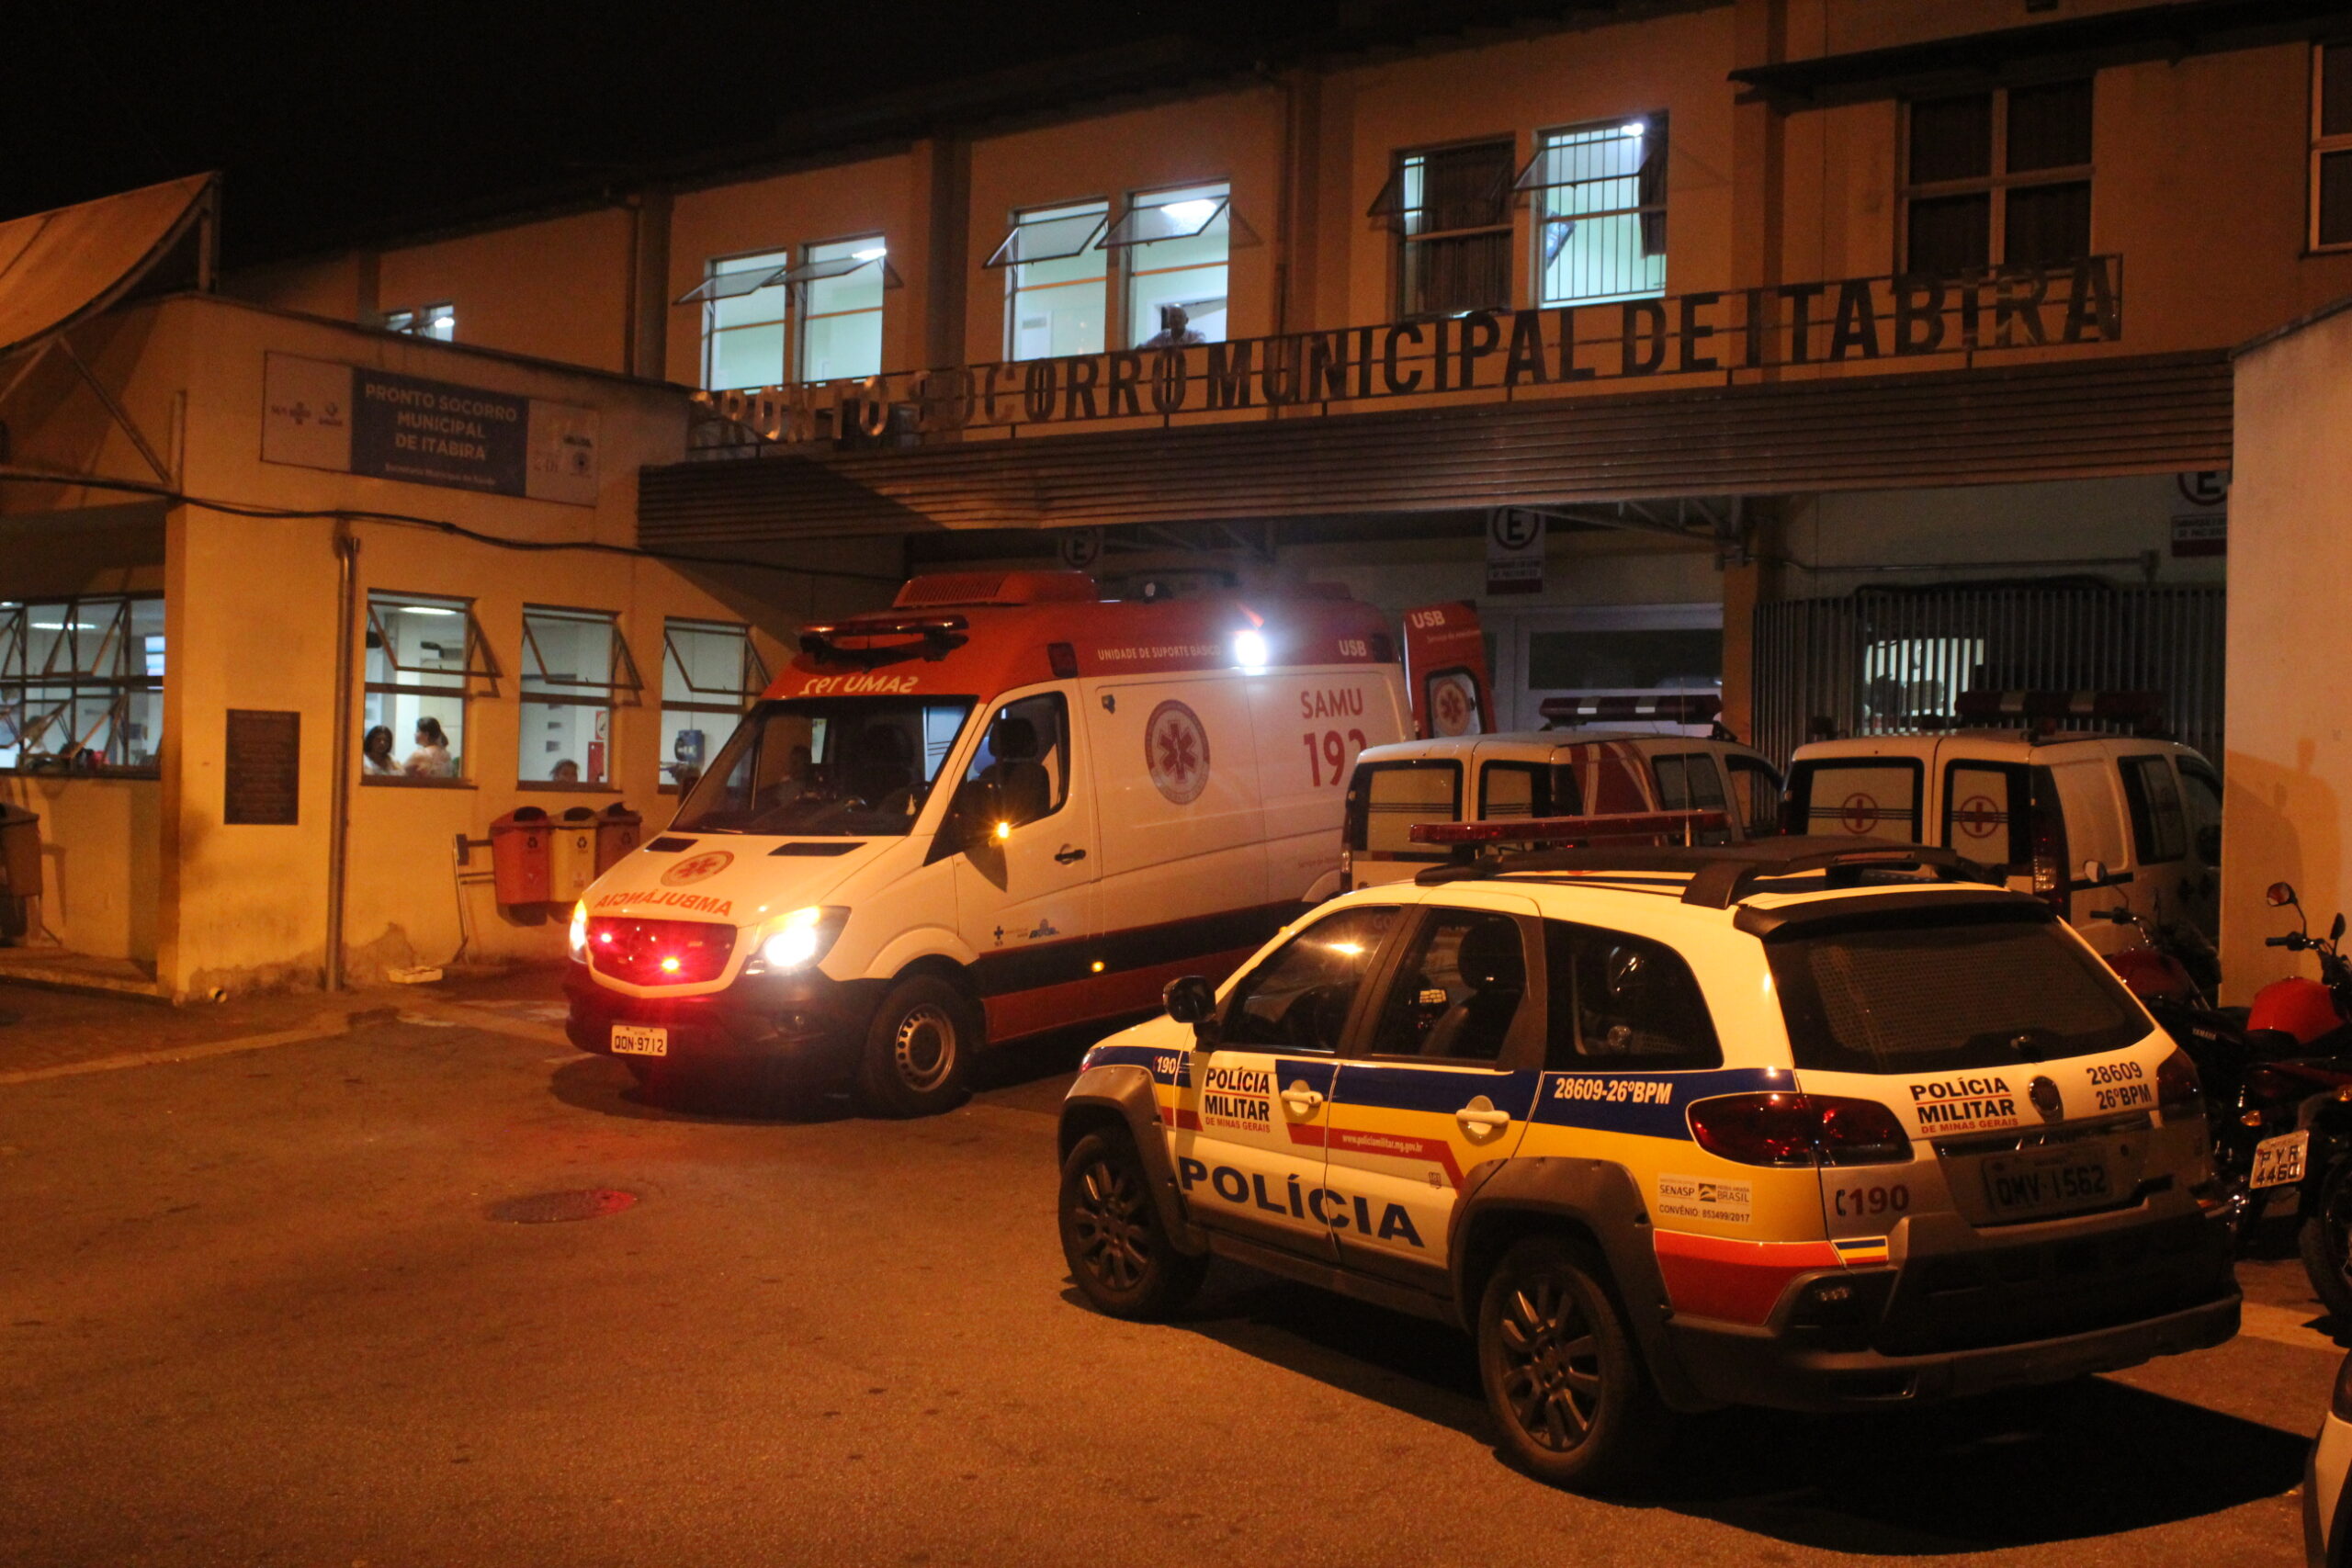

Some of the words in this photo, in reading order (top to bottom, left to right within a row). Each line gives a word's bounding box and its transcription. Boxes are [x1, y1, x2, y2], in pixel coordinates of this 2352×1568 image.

[908, 345, 1187, 432] SOCORRO
[1205, 307, 1596, 412] MUNICIPAL
[1623, 290, 1719, 377] DE
[1747, 254, 2120, 365] ITABIRA
[366, 383, 435, 408] PRONTO
[439, 395, 516, 423] SOCORRO
[398, 412, 485, 439] MUNICIPAL
[396, 434, 417, 450] DE
[423, 436, 485, 461] ITABIRA
[1508, 508, 1525, 541] E
[1411, 610, 1445, 629] USB
[1098, 648, 1136, 660] UNIDADE
[1139, 647, 1150, 659] DE
[1152, 646, 1189, 658] SUPORTE
[1339, 639, 1366, 657] USB
[1301, 688, 1363, 719] SAMU
[1158, 1056, 1177, 1074] 190
[2086, 1061, 2143, 1085] 28609
[1205, 1066, 1269, 1093] POLÍCIA
[1910, 1077, 2010, 1100] POLÍCIA
[1205, 1095, 1269, 1122] MILITAR
[1917, 1099, 2016, 1123] MILITAR
[1205, 1117, 1215, 1126] DE
[1217, 1118, 1239, 1129] MINAS
[1243, 1121, 1271, 1133] GERAIS
[1921, 1124, 1935, 1134] DE
[1939, 1121, 1975, 1132] MINAS
[1979, 1118, 2018, 1129] GERAIS
[1342, 1134, 1423, 1153] www.policiamilitar.mg.gov.br
[2261, 1145, 2299, 1168] PYR
[2256, 1162, 2299, 1185] 4460
[1179, 1156, 1425, 1248] POLÍCIA
[1660, 1184, 1694, 1197] SENASP
[1718, 1190, 1750, 1202] BRASIL
[1849, 1184, 1909, 1214] 190
